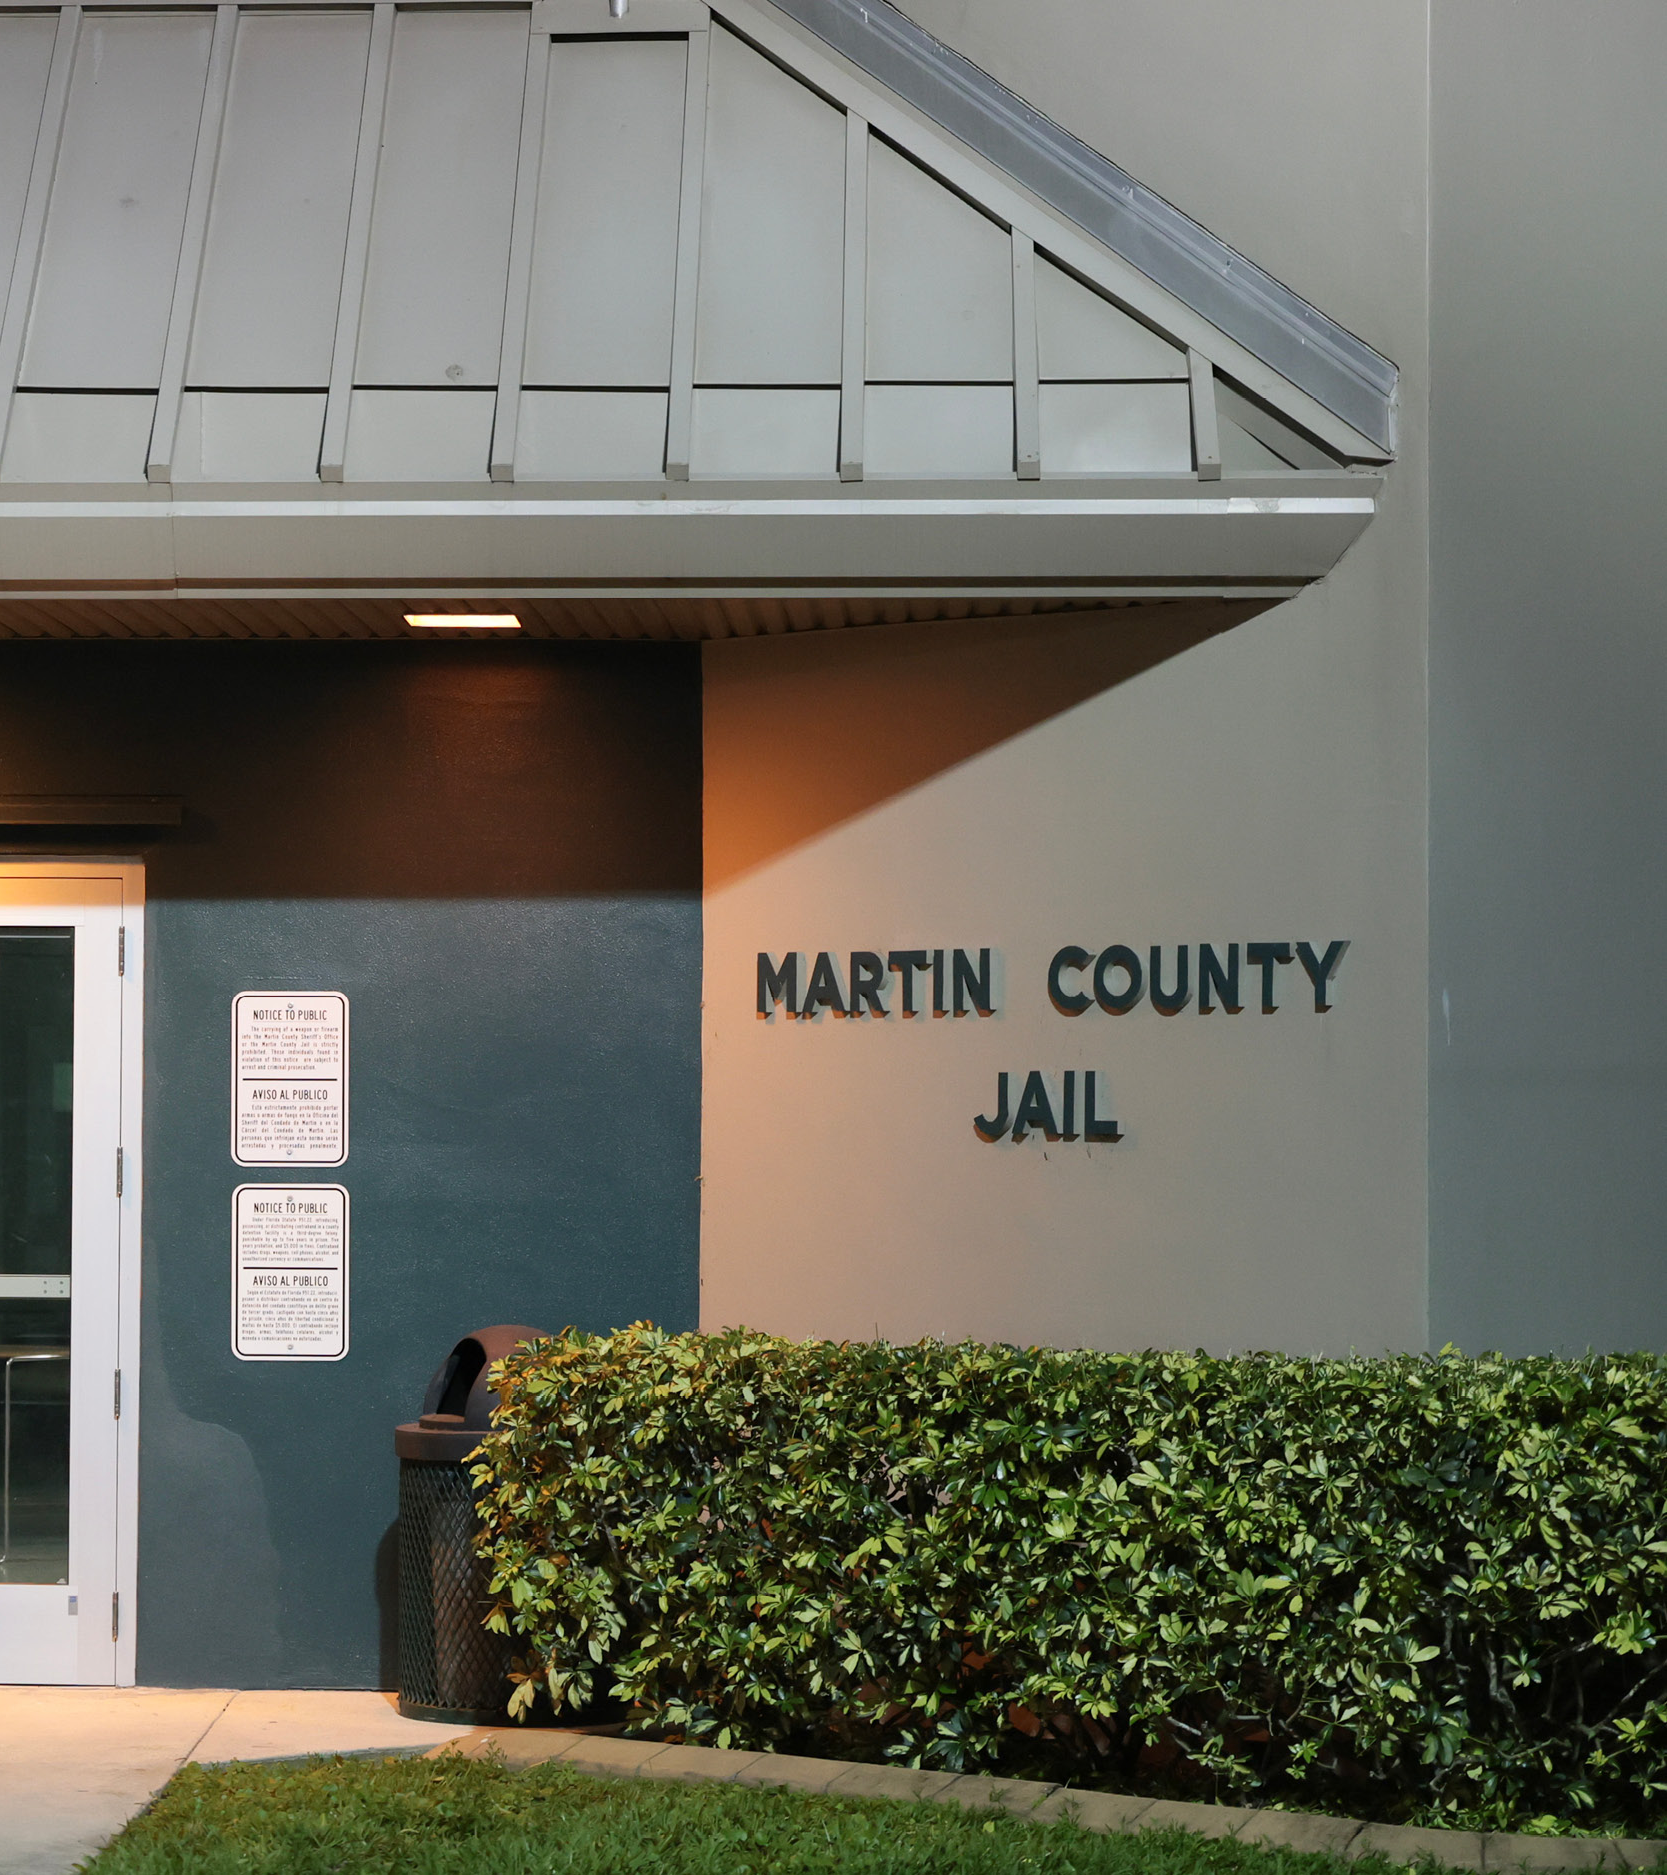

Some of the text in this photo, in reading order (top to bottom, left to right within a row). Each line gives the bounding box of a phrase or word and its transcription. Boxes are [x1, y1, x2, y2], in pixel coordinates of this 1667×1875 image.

[756, 940, 1350, 1019] MARTIN COUNTY
[253, 1010, 327, 1020] NOTICE TO PUBLIC
[252, 1089, 328, 1100] AVISO AL PUBLICO
[973, 1070, 1124, 1142] JAIL
[253, 1203, 328, 1213] NOTICE TO PUBLIC
[253, 1276, 329, 1286] AVISO AL PUBLICO
